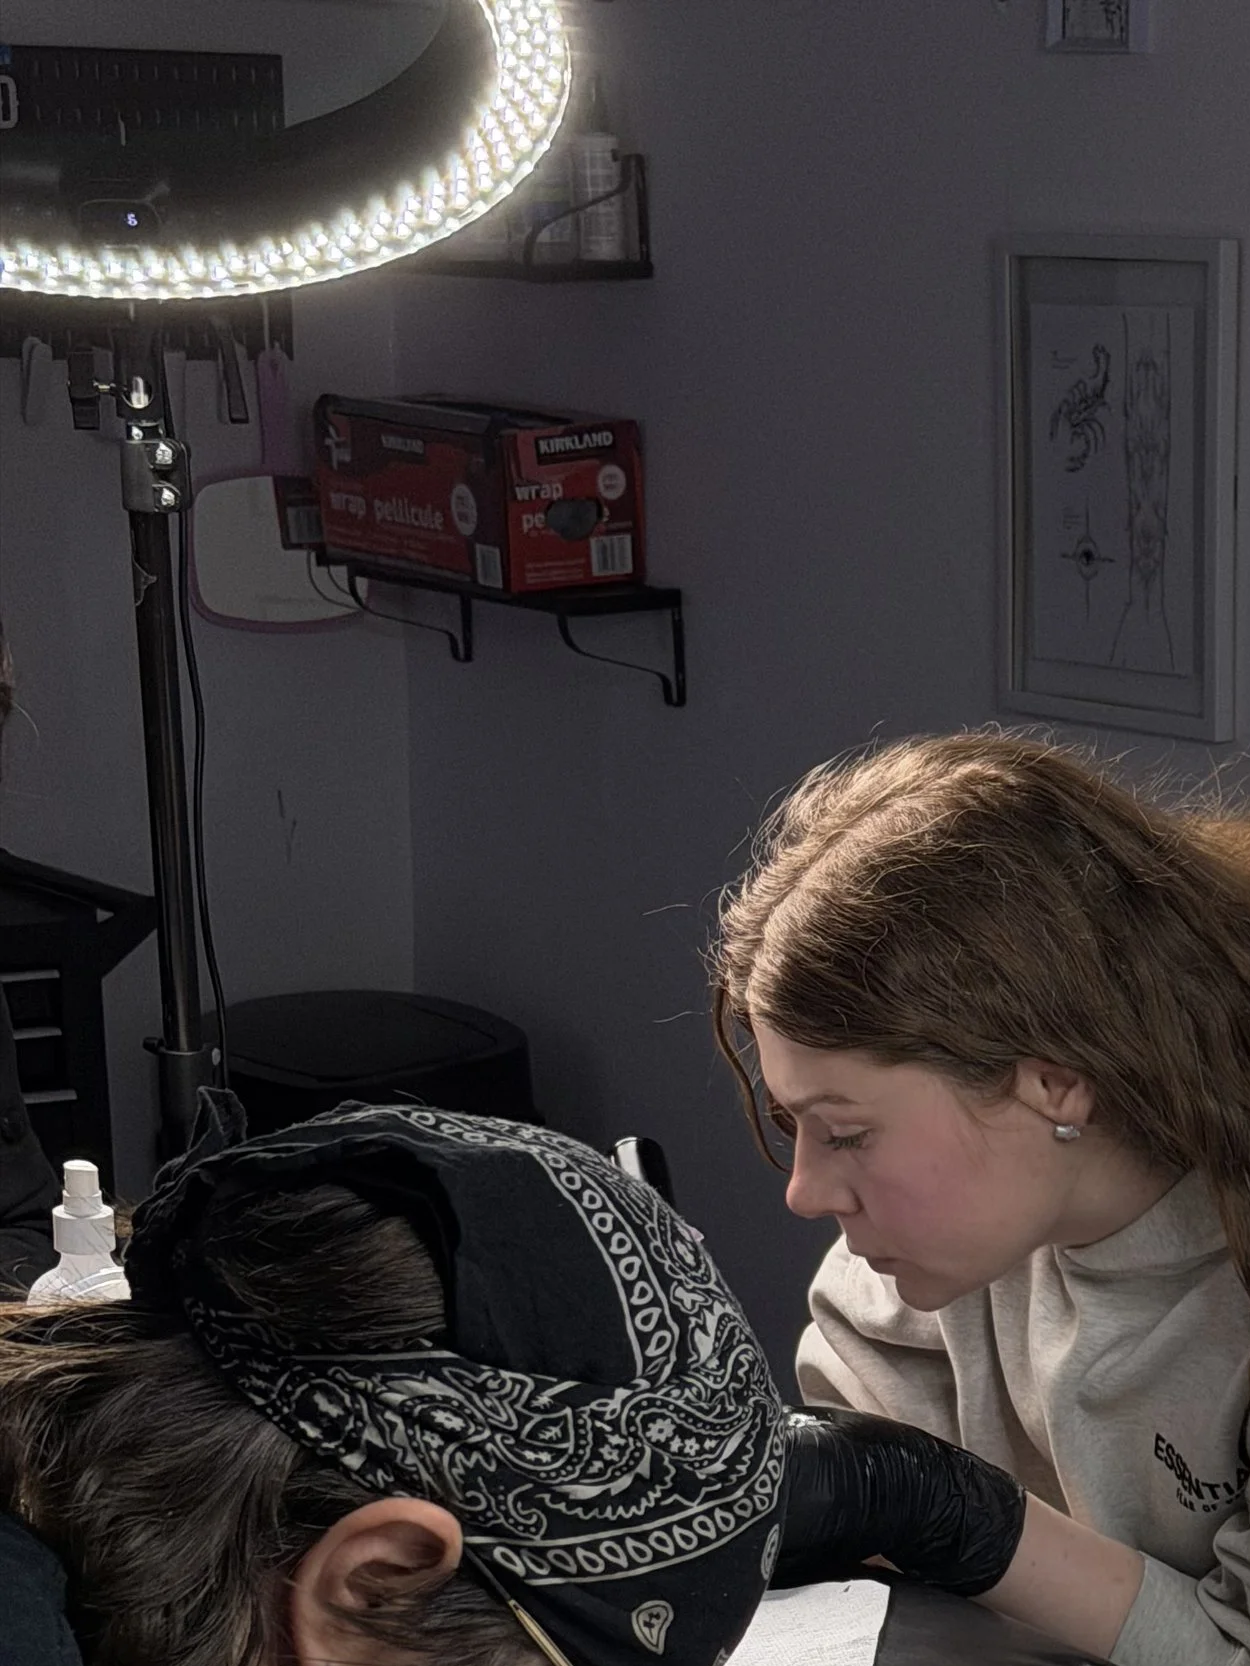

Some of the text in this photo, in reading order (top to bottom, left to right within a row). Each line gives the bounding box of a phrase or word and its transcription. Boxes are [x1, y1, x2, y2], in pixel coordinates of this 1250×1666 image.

[537, 431, 614, 456] KIRKLAND
[514, 482, 564, 502] wrap
[330, 491, 366, 520] wrap
[373, 496, 445, 531] pellicule
